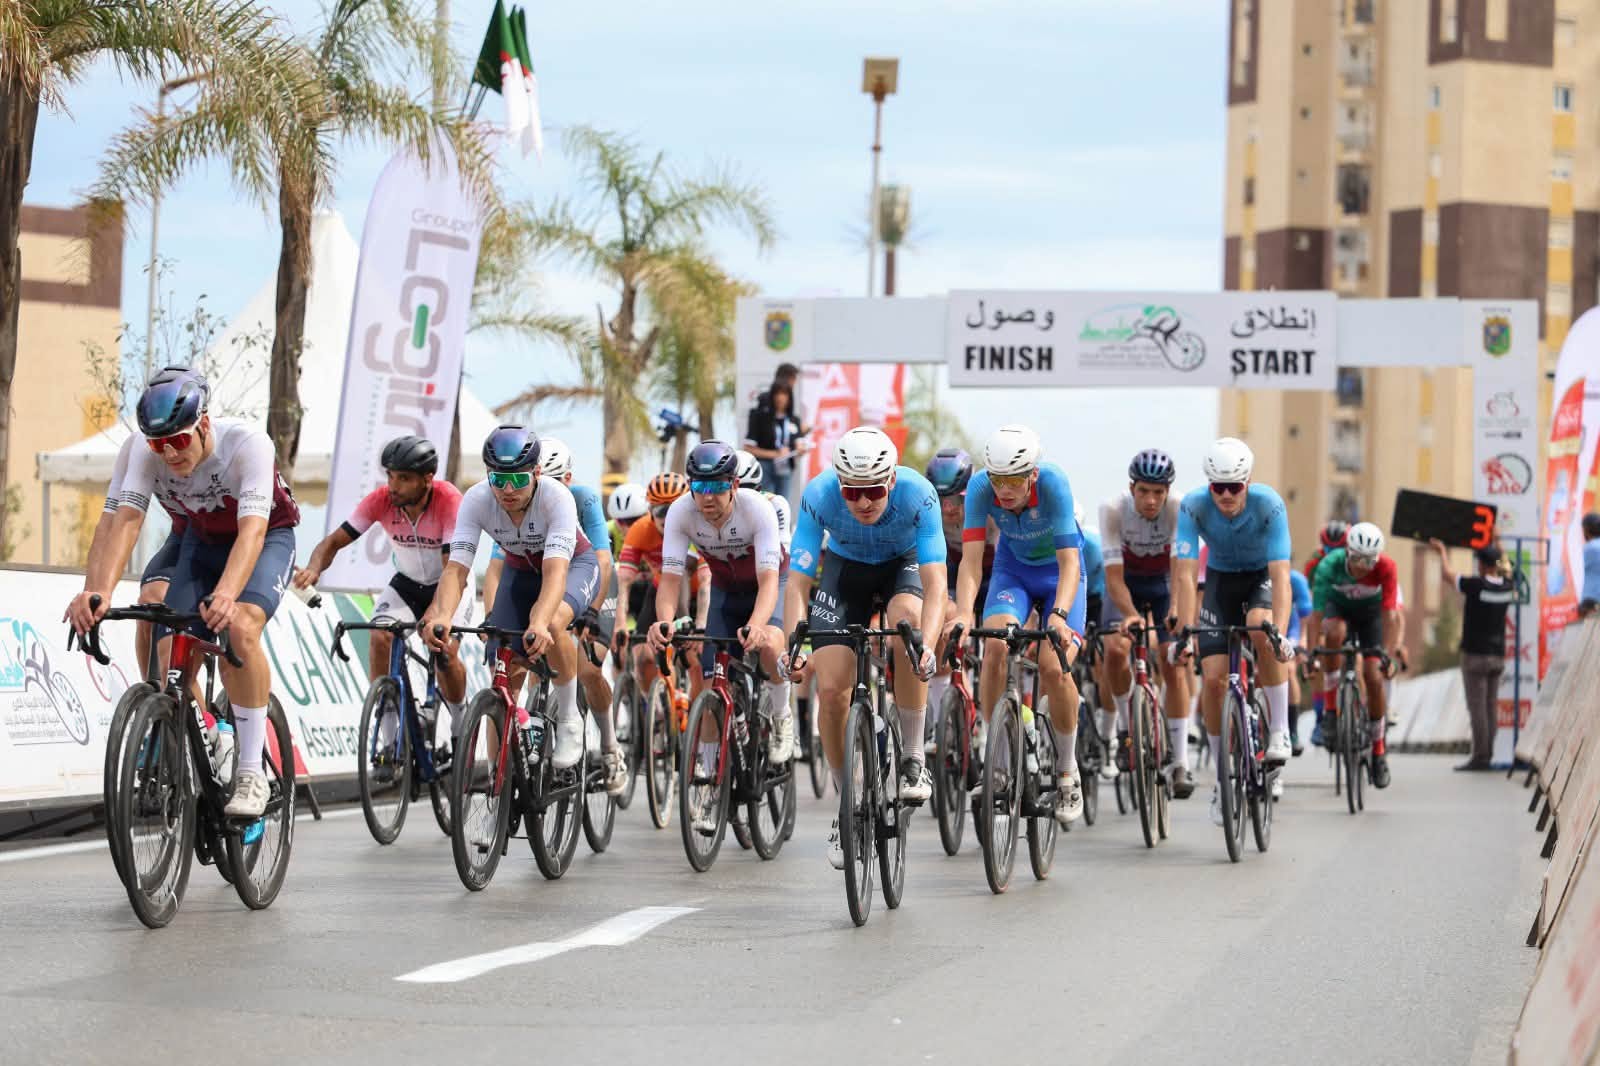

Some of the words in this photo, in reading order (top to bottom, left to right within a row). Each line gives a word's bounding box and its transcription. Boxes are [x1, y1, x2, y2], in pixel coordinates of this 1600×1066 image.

[965, 300, 1054, 330] وصول
[964, 346, 1052, 371] FINISH
[1231, 349, 1316, 375] START
[1470, 505, 1494, 548] 3
